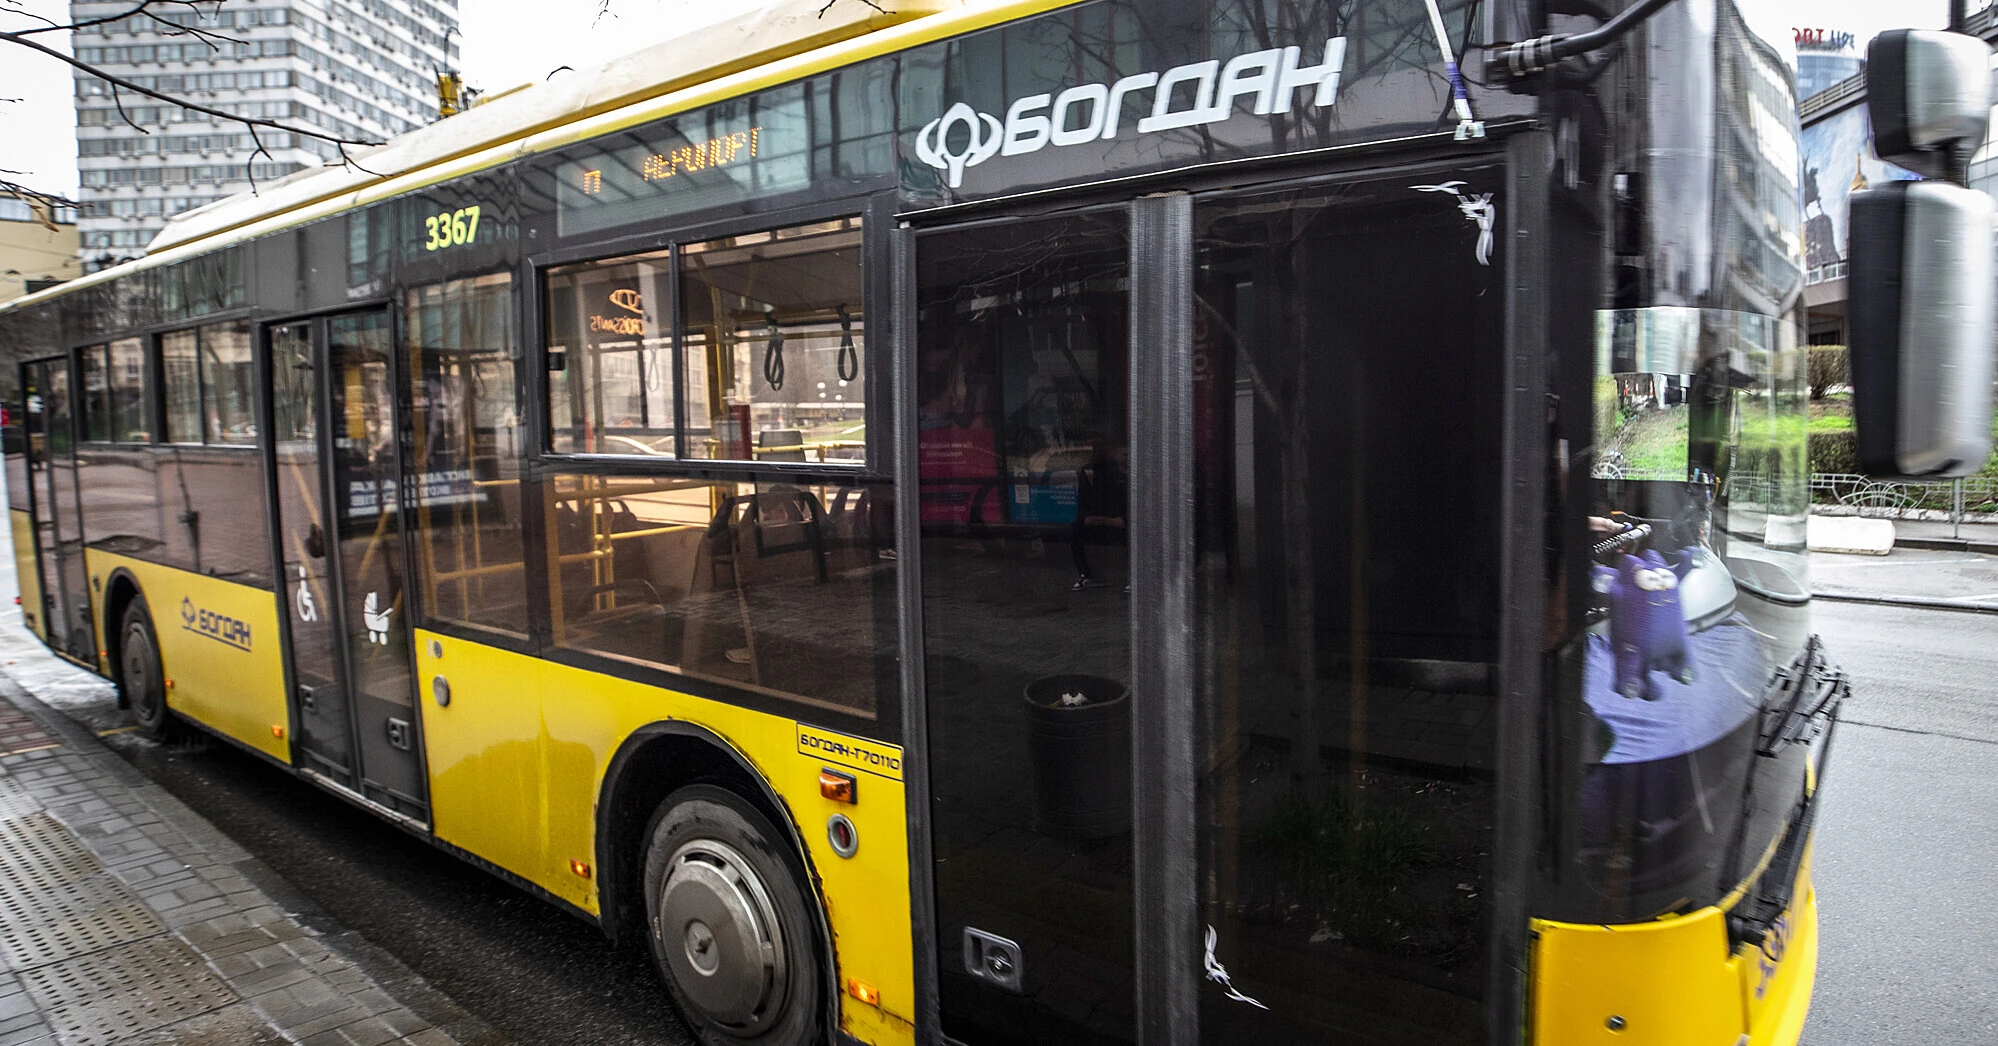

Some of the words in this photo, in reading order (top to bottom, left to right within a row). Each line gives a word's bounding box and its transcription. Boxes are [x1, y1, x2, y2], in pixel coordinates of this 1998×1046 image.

[1001, 36, 1347, 156] БОГДАН
[425, 205, 480, 251] 3367
[199, 608, 252, 647] БОГДАН
[800, 733, 900, 770] БОГДАН-Т70110
